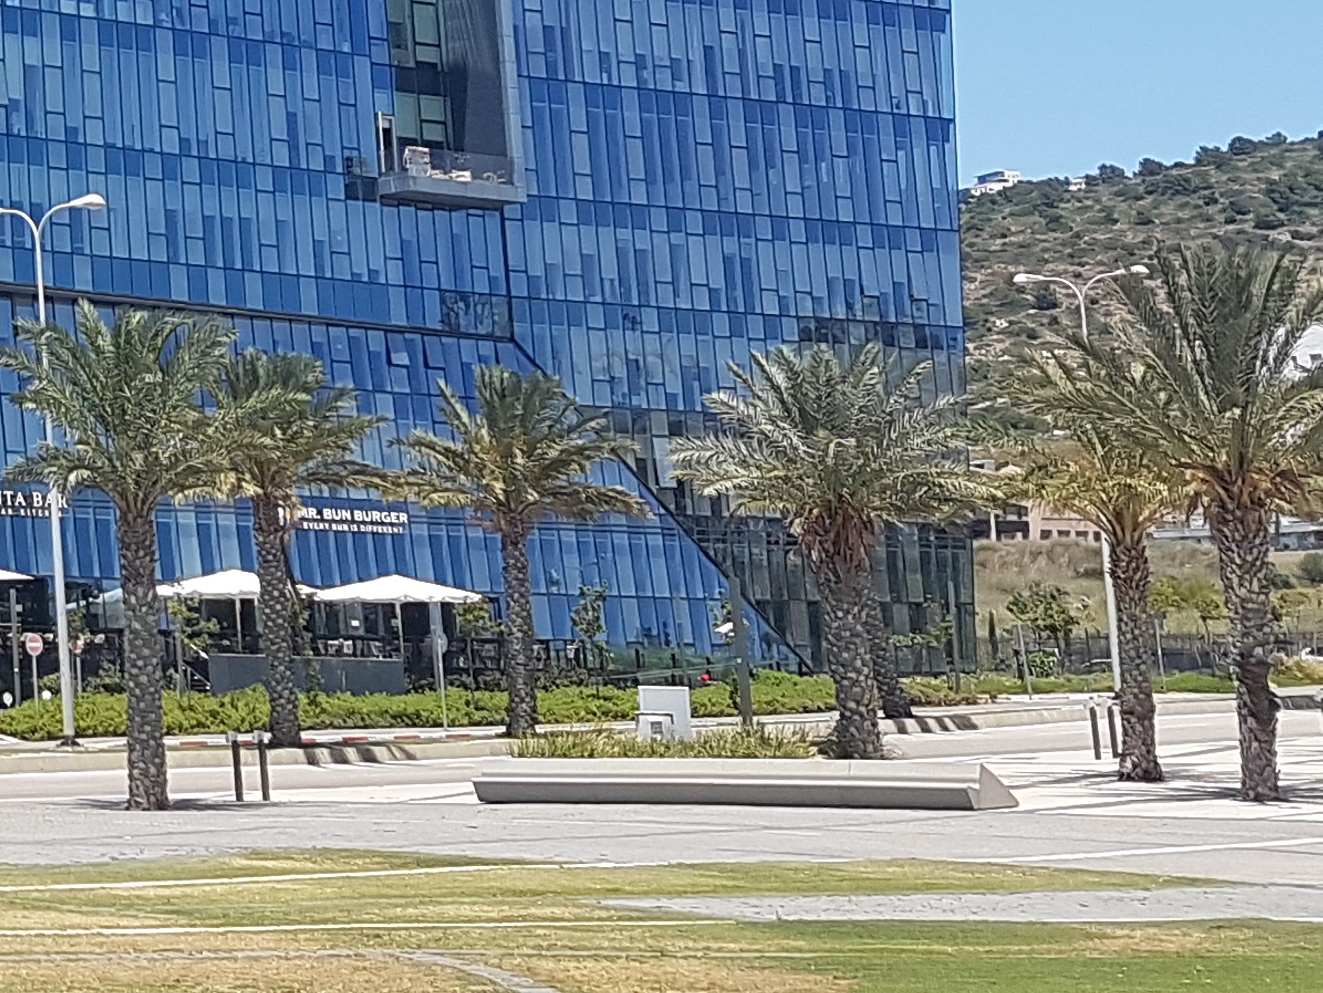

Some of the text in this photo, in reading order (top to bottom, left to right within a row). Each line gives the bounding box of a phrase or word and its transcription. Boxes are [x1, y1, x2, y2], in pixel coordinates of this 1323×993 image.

[32, 491, 69, 509] BAR
[297, 508, 408, 524] MR. BUN BURGER
